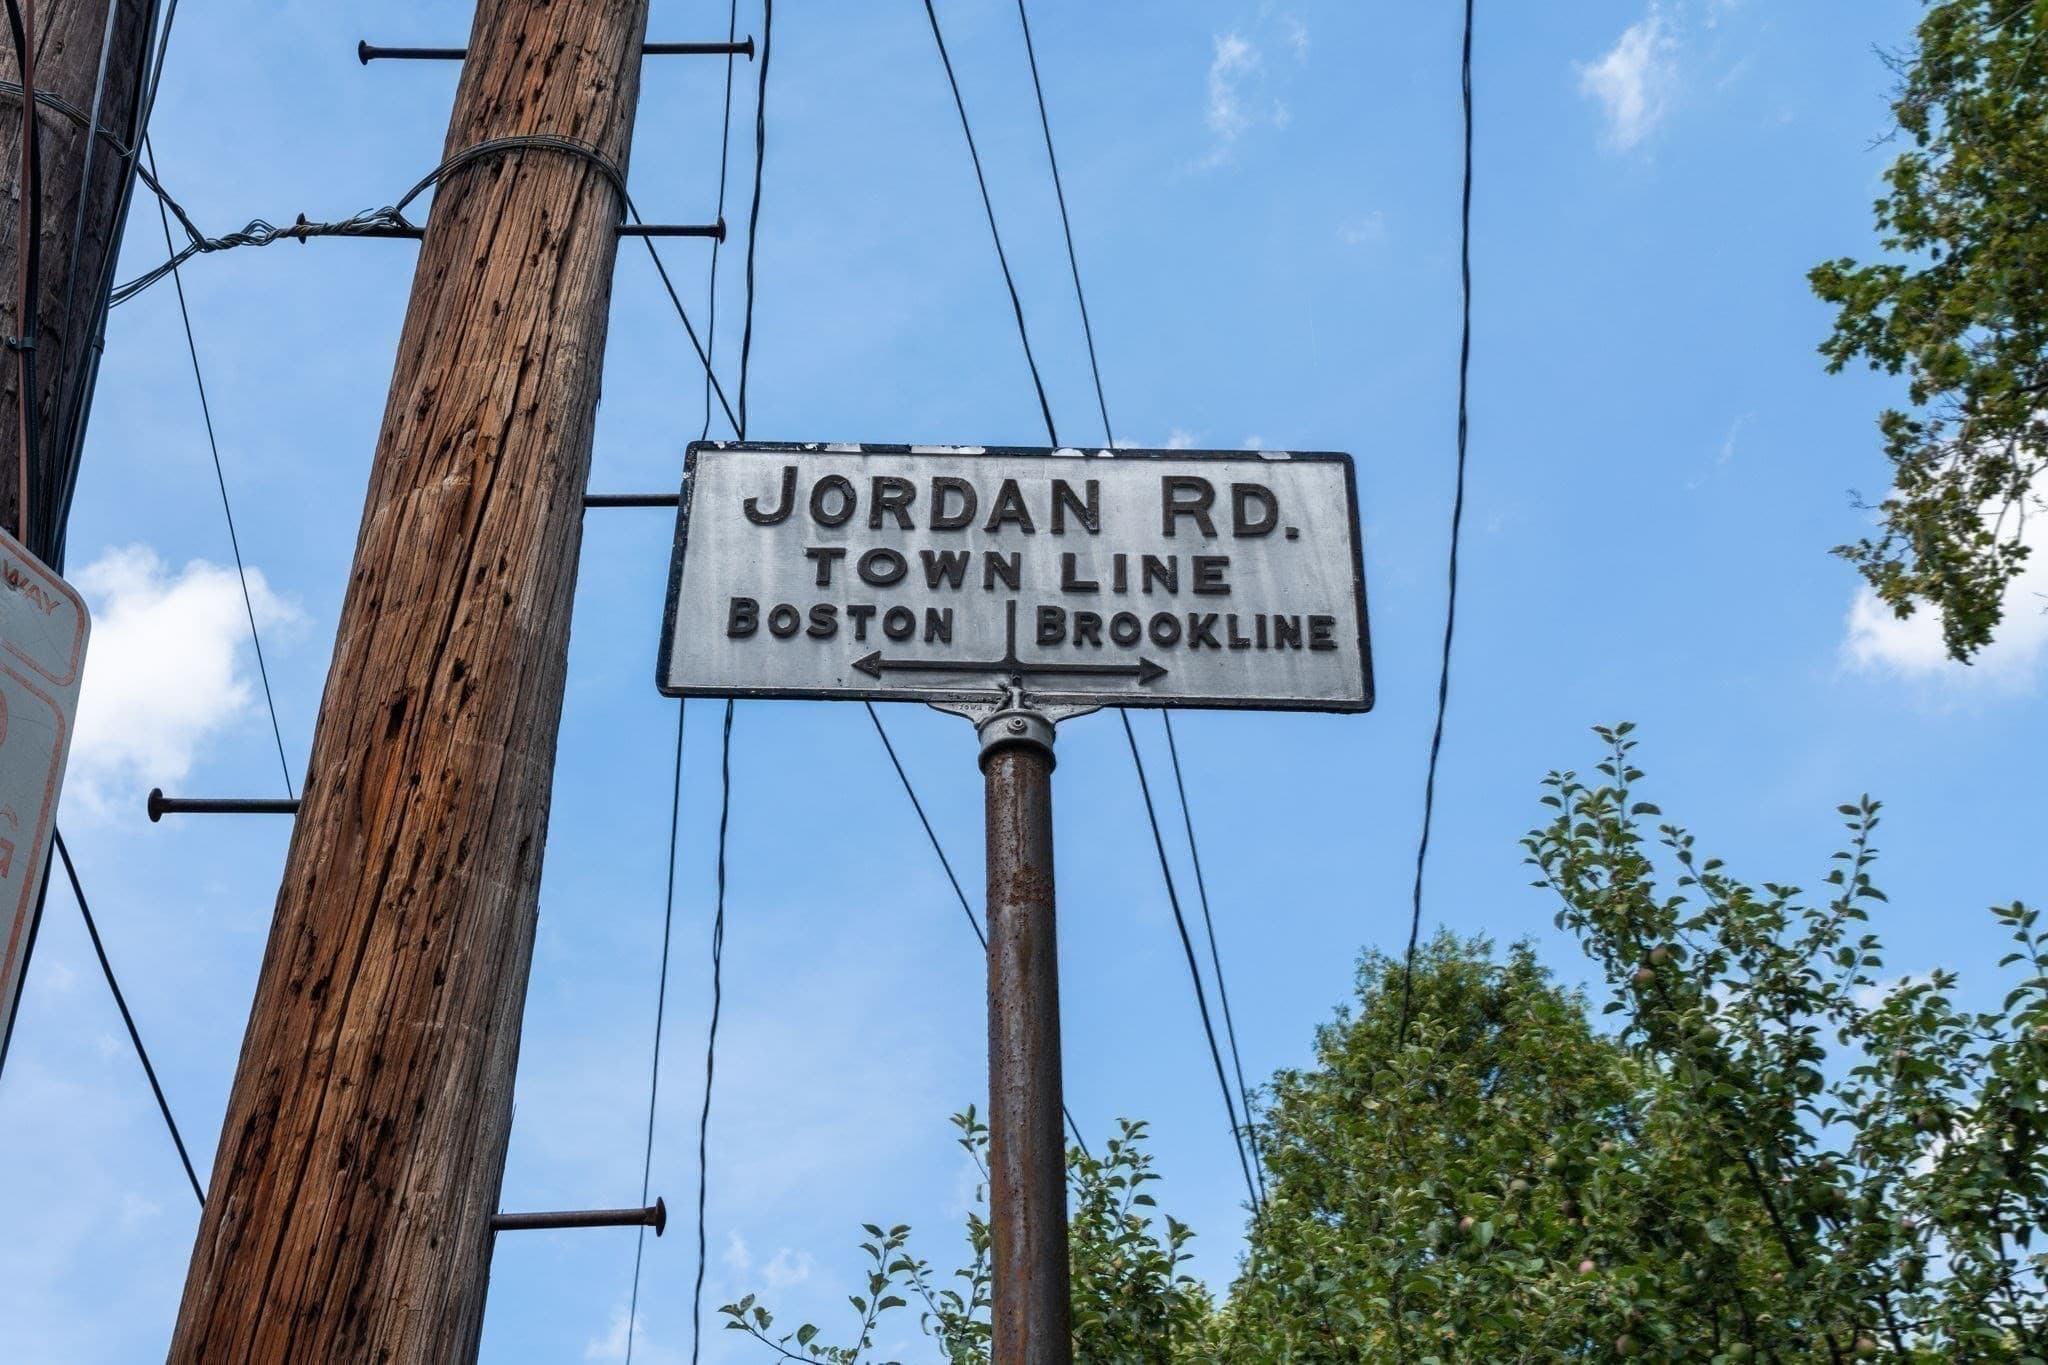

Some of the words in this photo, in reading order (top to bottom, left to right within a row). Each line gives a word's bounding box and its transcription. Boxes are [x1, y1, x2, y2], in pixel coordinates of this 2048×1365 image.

[743, 465, 1101, 535] JORDAN
[1161, 475, 1300, 540] RD.
[805, 547, 1021, 591] TOWN
[1060, 552, 1231, 595] LINE
[726, 597, 952, 644] BOSTON
[1035, 605, 1338, 650] BROOKLINE
